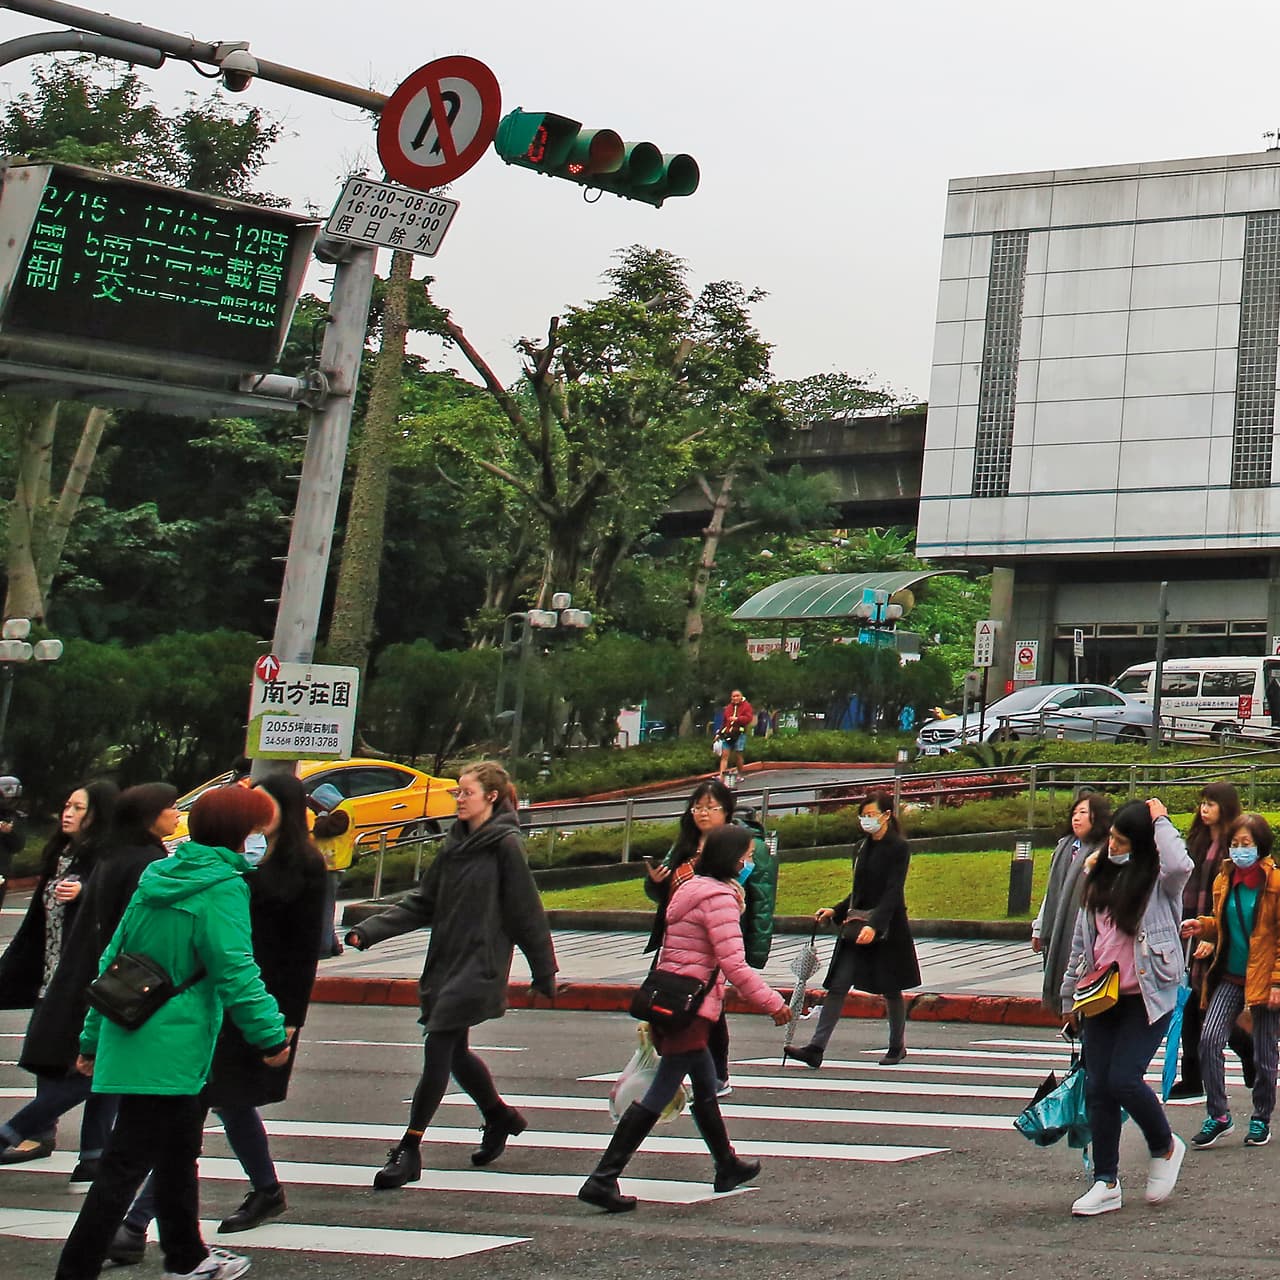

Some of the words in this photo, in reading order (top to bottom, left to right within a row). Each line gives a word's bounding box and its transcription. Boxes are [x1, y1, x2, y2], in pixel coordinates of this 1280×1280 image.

[335, 215, 432, 251] 假日除外
[261, 680, 351, 708] 南方莊園
